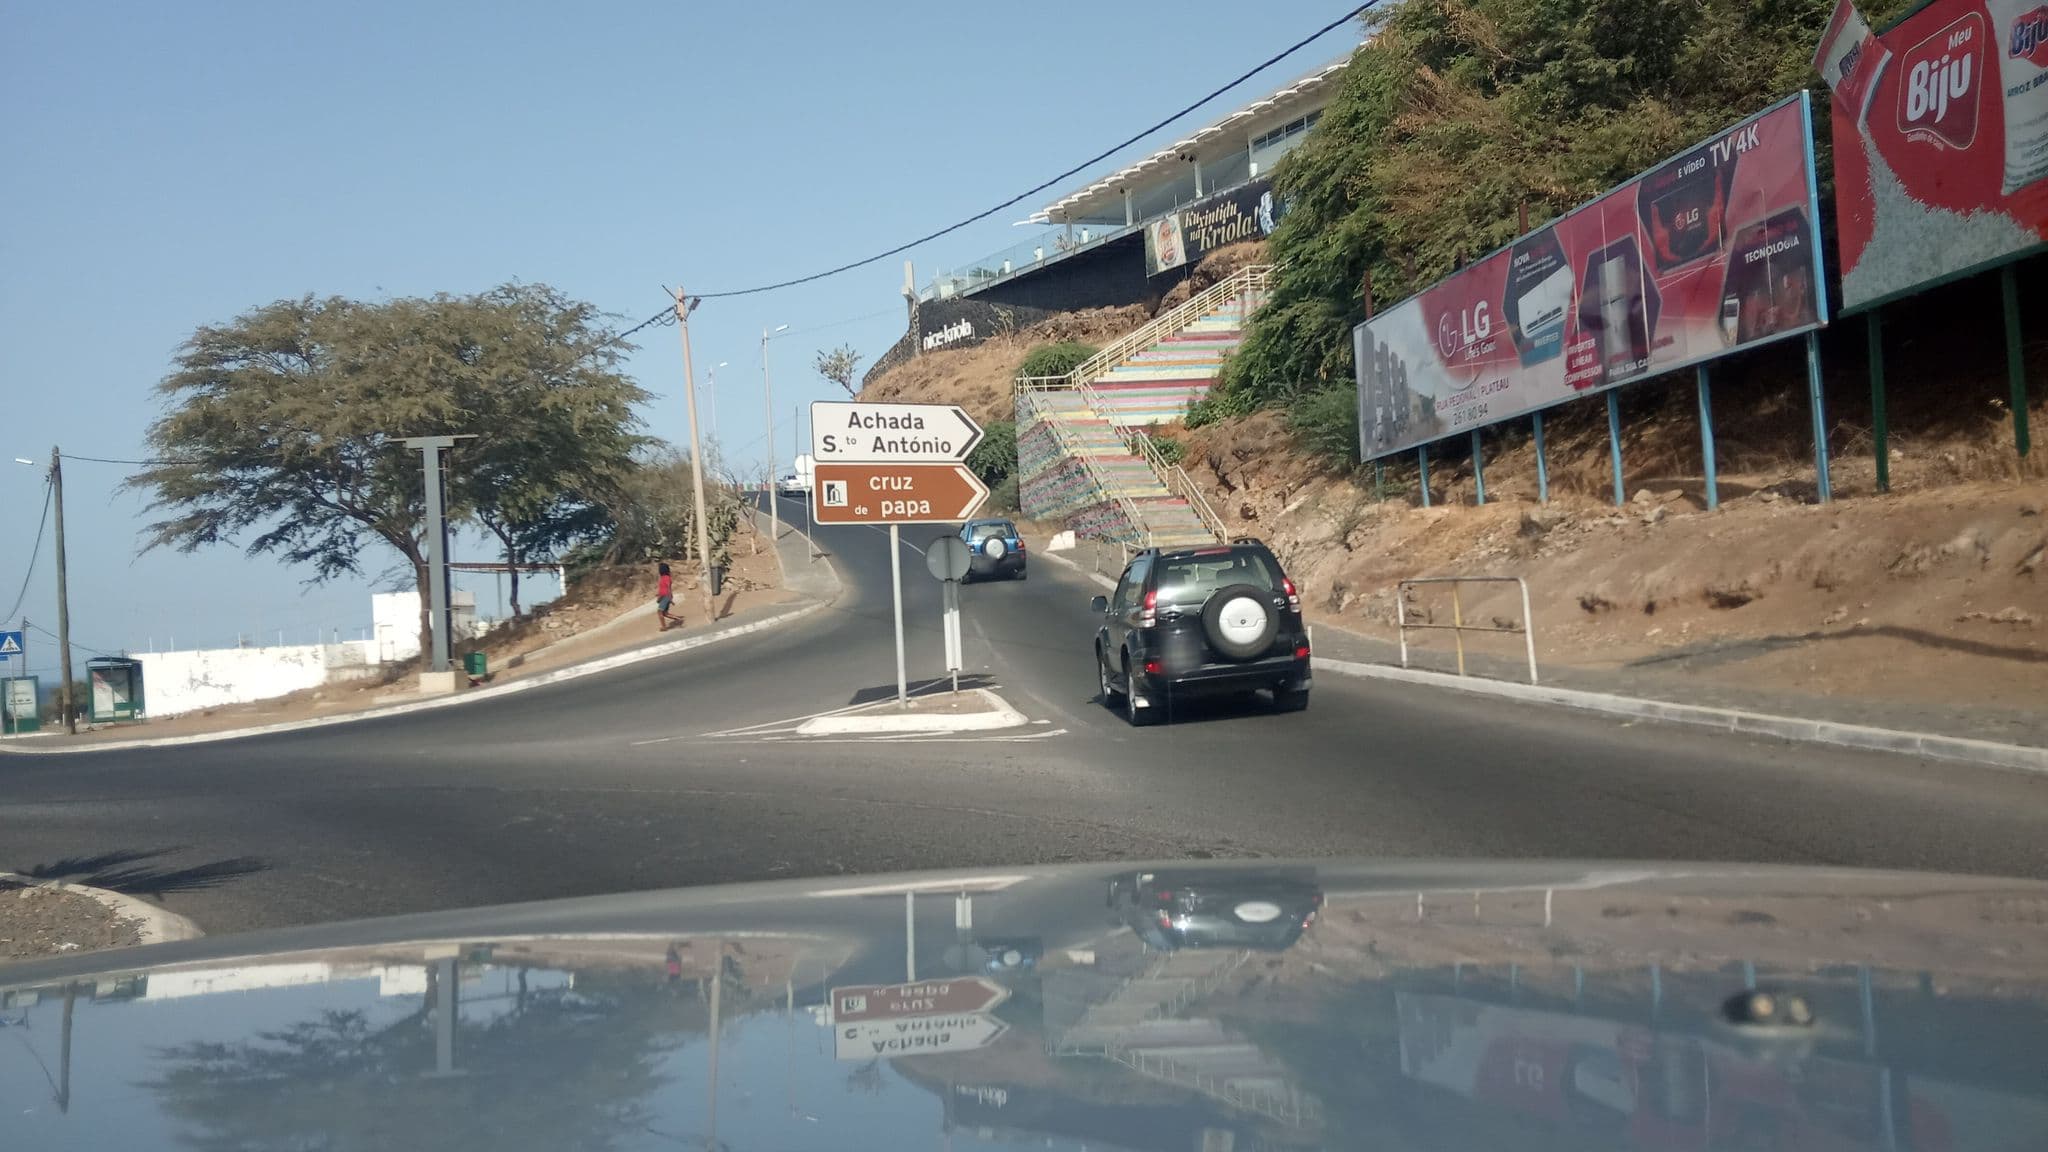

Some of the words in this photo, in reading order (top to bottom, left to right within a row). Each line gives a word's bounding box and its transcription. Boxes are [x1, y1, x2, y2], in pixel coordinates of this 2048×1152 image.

[1947, 26, 1973, 51] Meu
[1906, 52, 1972, 123] Biju
[1678, 168, 1682, 178] E
[1683, 157, 1706, 177] VÍDEO
[1709, 137, 1732, 167] TV
[1736, 122, 1760, 153] 4K
[1686, 208, 1699, 224] LG
[1200, 205, 1258, 252] Kriola!
[1462, 300, 1491, 345] LG
[848, 411, 925, 430] Achada
[872, 435, 951, 453] António
[869, 476, 913, 490] cruz
[854, 505, 868, 515] de
[881, 500, 931, 517] papa
